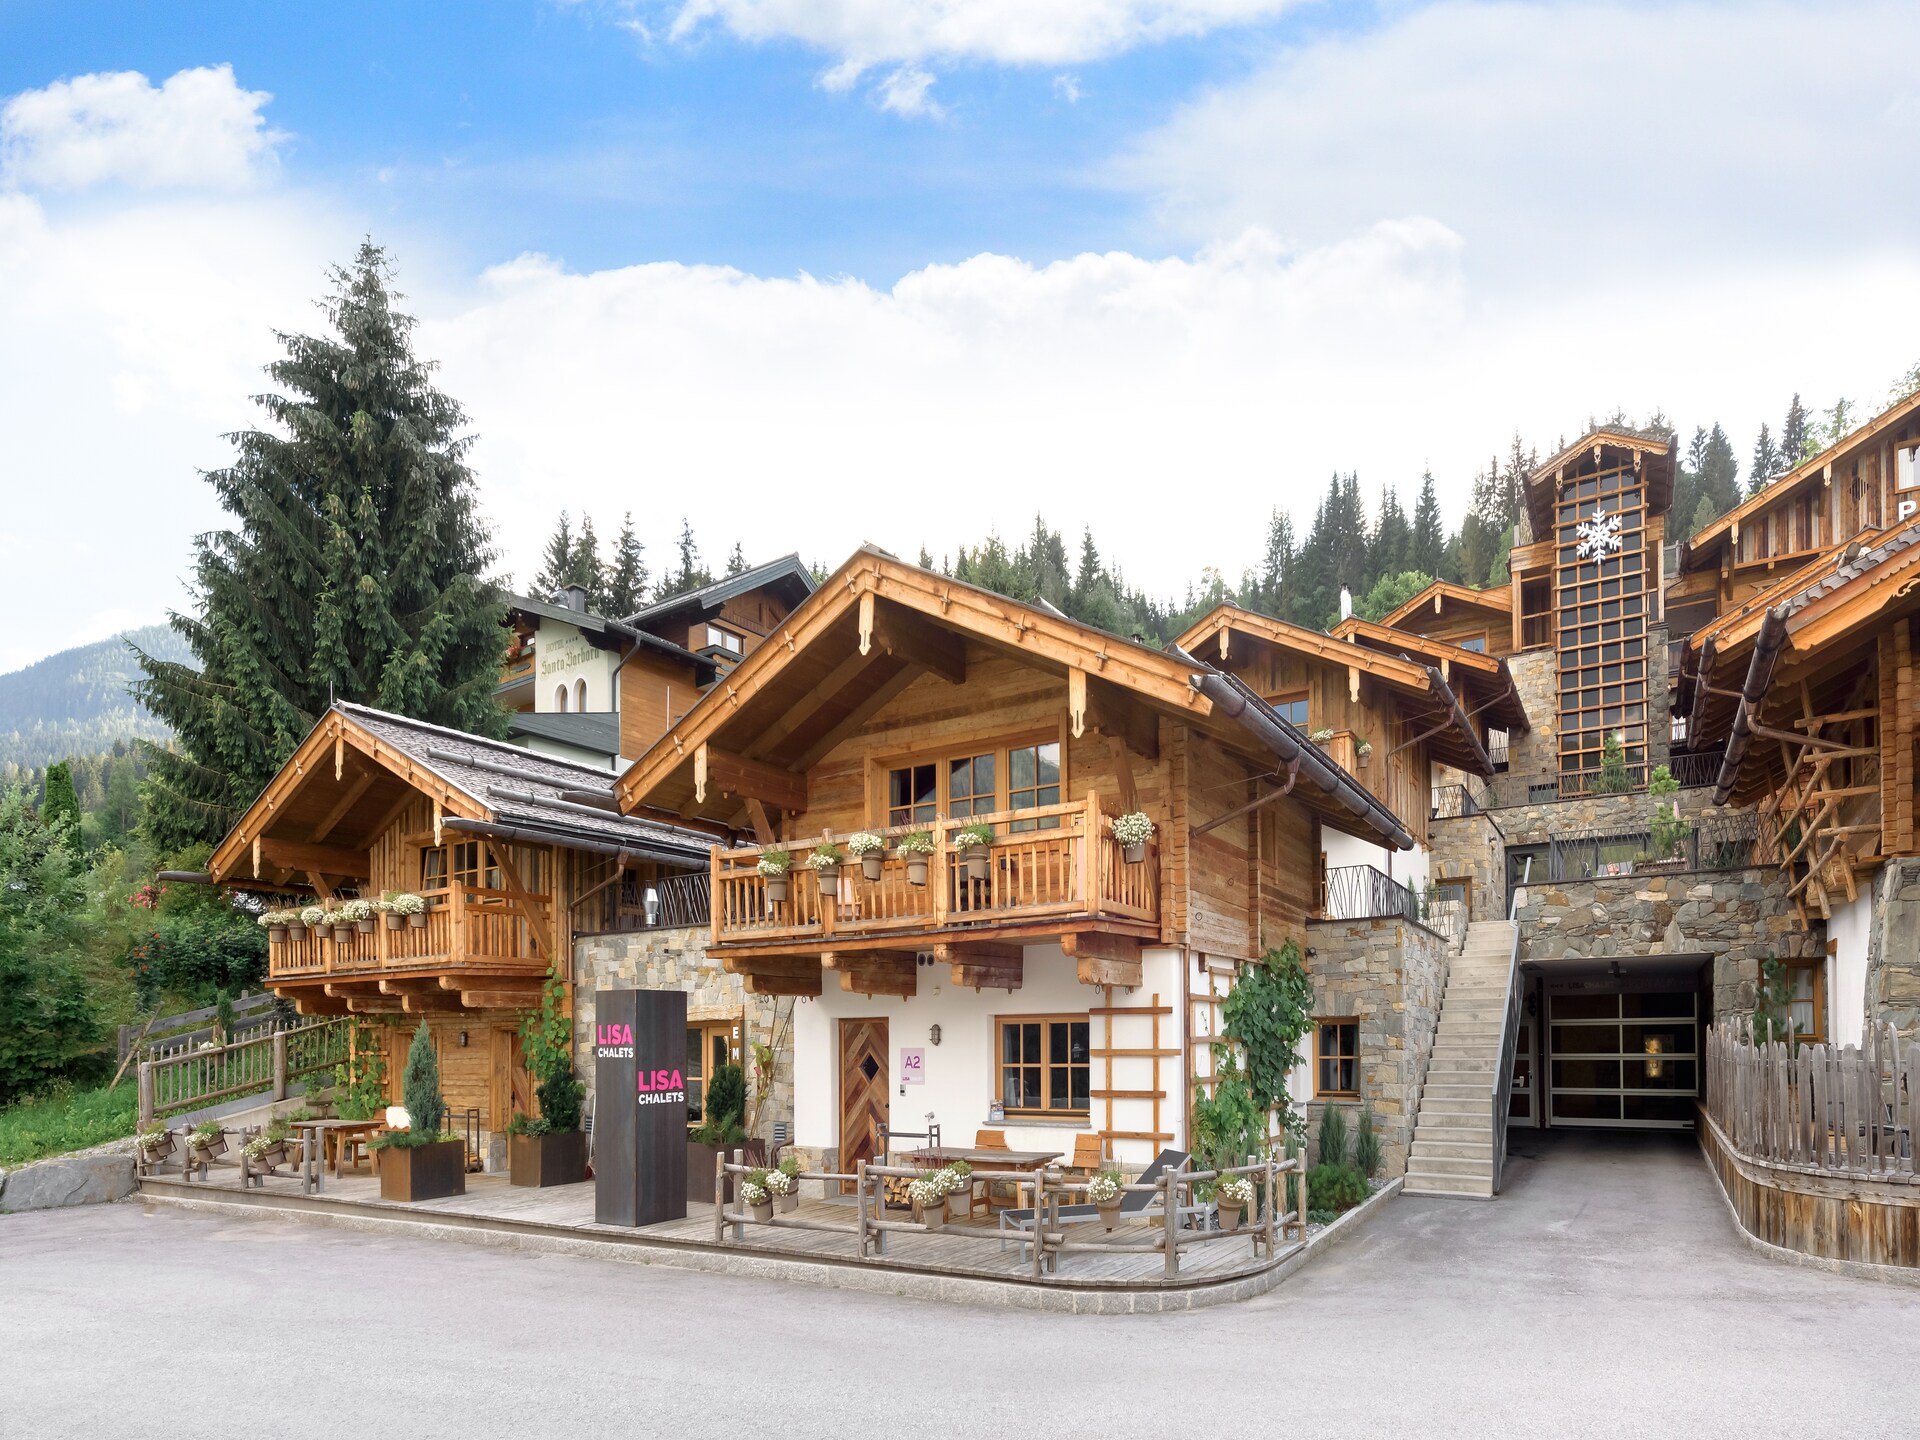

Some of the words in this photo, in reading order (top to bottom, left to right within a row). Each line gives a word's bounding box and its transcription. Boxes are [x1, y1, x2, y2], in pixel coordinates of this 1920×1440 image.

[598, 1024, 633, 1045] LISA
[598, 1047, 634, 1058] CHALETS
[904, 1056, 921, 1069] A2
[638, 1070, 684, 1092] LISA
[638, 1092, 685, 1105] CHALETS
